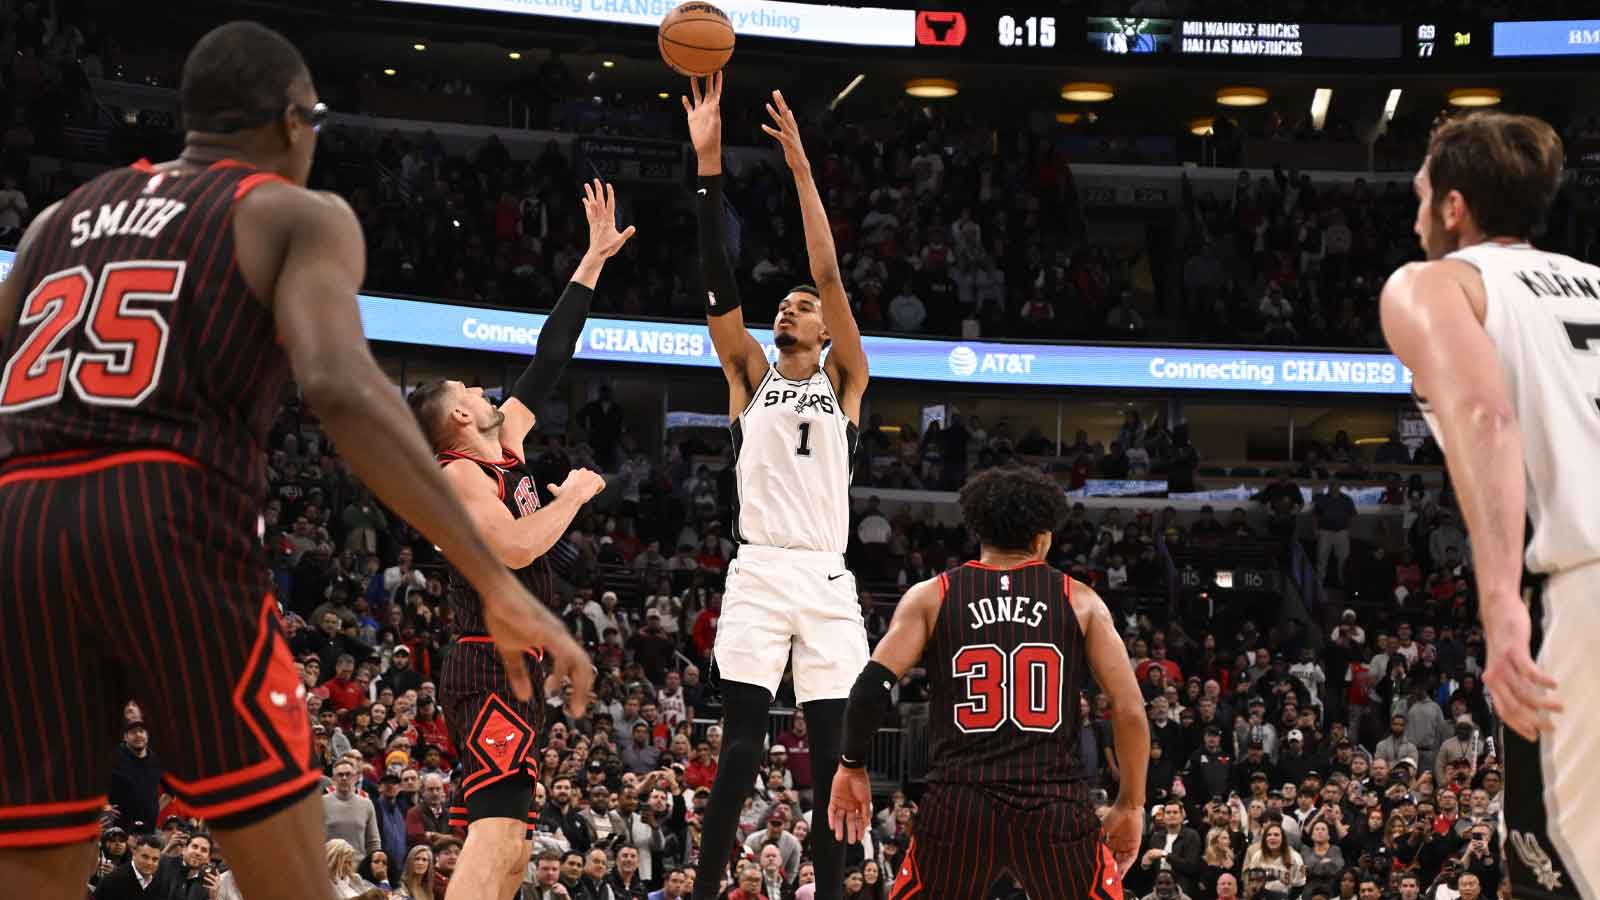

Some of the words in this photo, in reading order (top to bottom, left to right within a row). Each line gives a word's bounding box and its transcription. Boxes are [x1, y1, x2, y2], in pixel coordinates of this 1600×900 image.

[730, 8, 800, 34] rything
[998, 15, 1056, 47] 9:15
[1257, 23, 1300, 39] BUCKS
[1182, 38, 1229, 54] DALLAS
[1231, 39, 1303, 56] MAVERICKS
[1418, 42, 1434, 58] 77
[1454, 31, 1471, 47] 3rd
[70, 197, 187, 248] SMITH
[1514, 270, 1600, 300] KORN
[0, 259, 187, 413] 25
[461, 317, 540, 348] Connec
[590, 328, 703, 356] CHANGES
[980, 352, 1036, 374] AT&T
[1150, 357, 1275, 385] Connecting
[1281, 360, 1396, 385] CHANGES
[764, 390, 835, 415] SPURS
[795, 422, 812, 456] 1
[967, 596, 1048, 630] JONES
[952, 642, 1064, 733] 30
